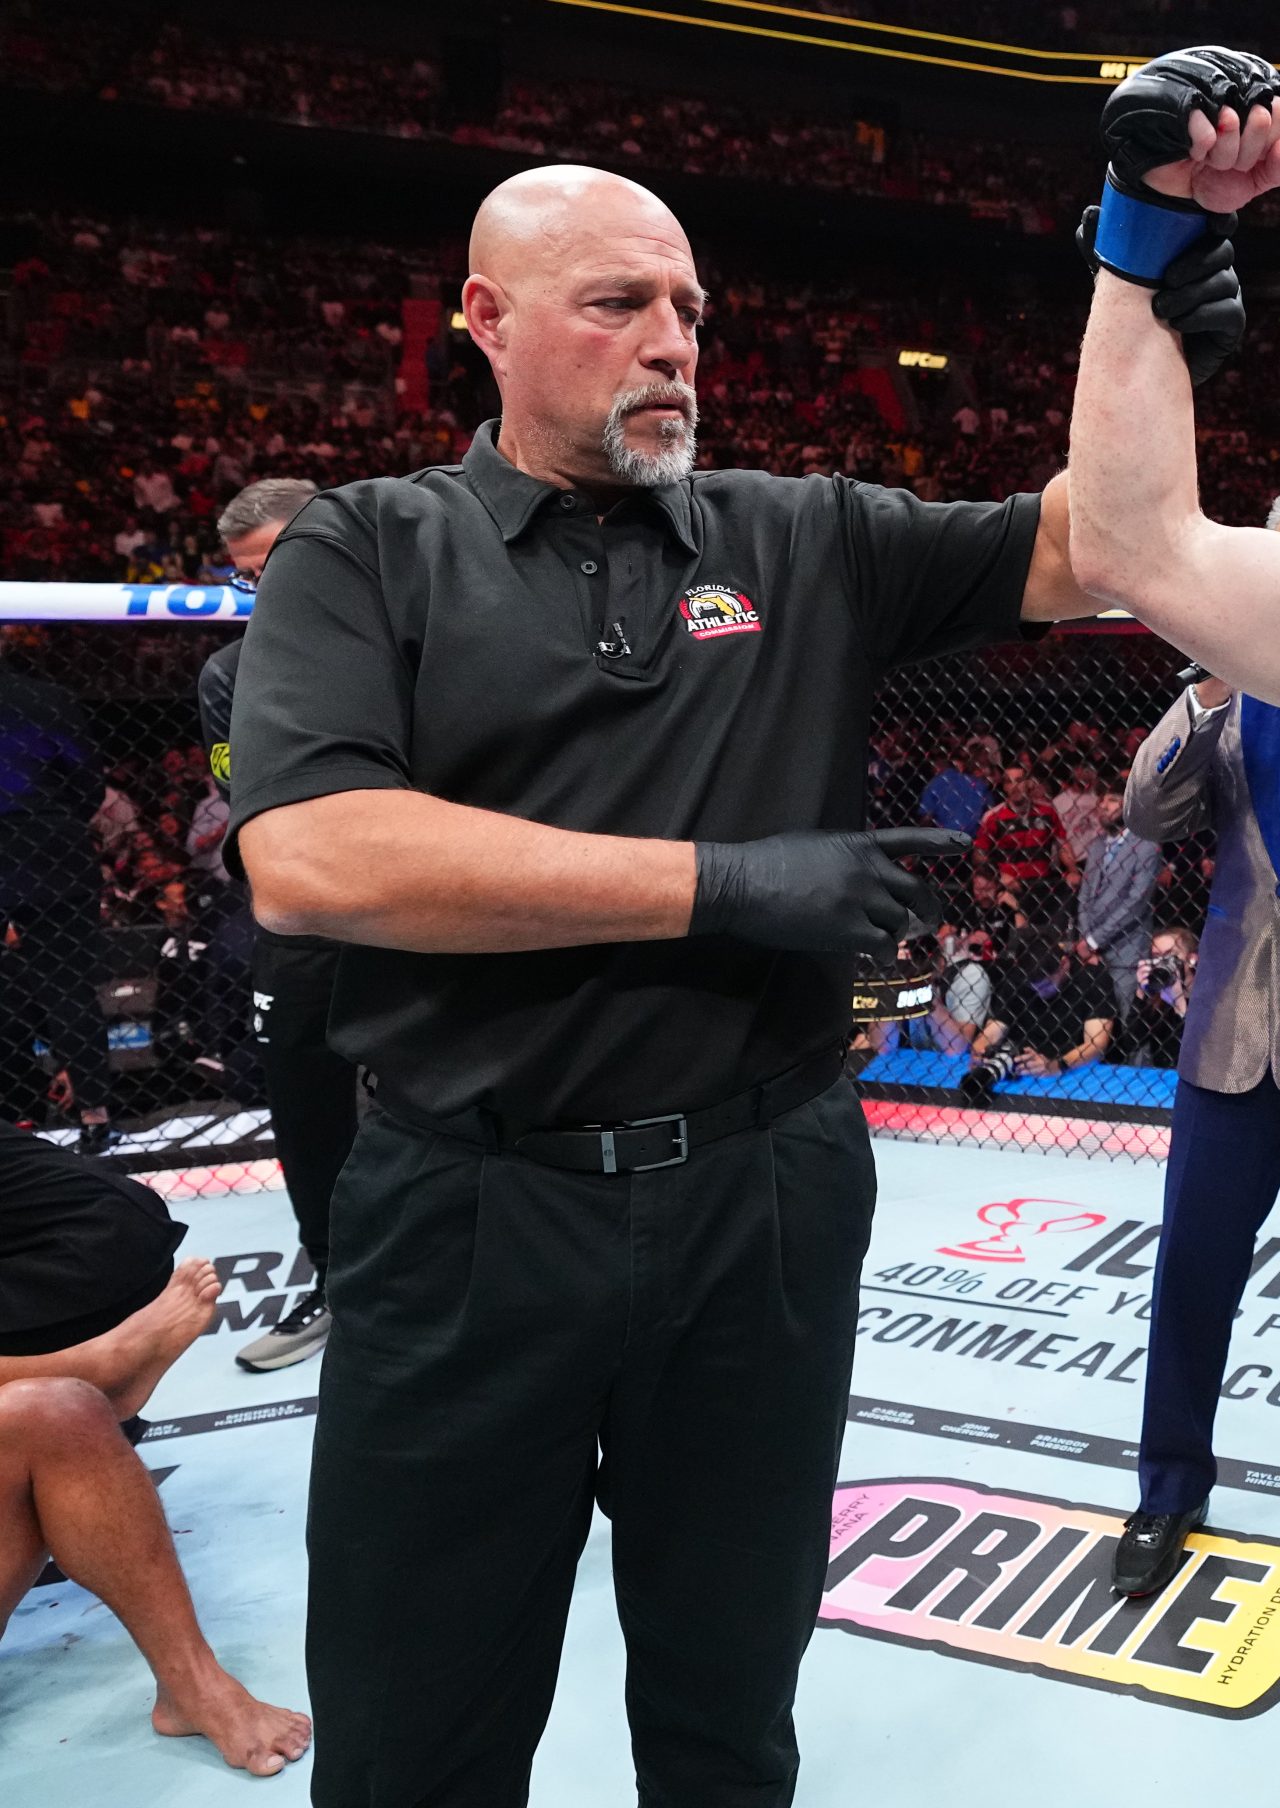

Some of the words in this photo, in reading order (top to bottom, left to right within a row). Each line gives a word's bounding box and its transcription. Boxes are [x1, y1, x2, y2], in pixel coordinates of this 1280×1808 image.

[685, 584, 733, 597] FLORIDA
[687, 610, 759, 632] ATHLETIC
[699, 623, 755, 637] COMMISSION
[873, 1261, 987, 1294] 40%
[995, 1277, 1099, 1307] OFF
[872, 1407, 914, 1419] CARLOS
[960, 1422, 991, 1432] JOHN
[1029, 1439, 1084, 1454] PARSONS
[1034, 1433, 1090, 1449] BRANDON
[832, 1493, 870, 1528] ERRY
[822, 1496, 1273, 1675] PRIME
[1217, 1606, 1277, 1686] HYDRATION
